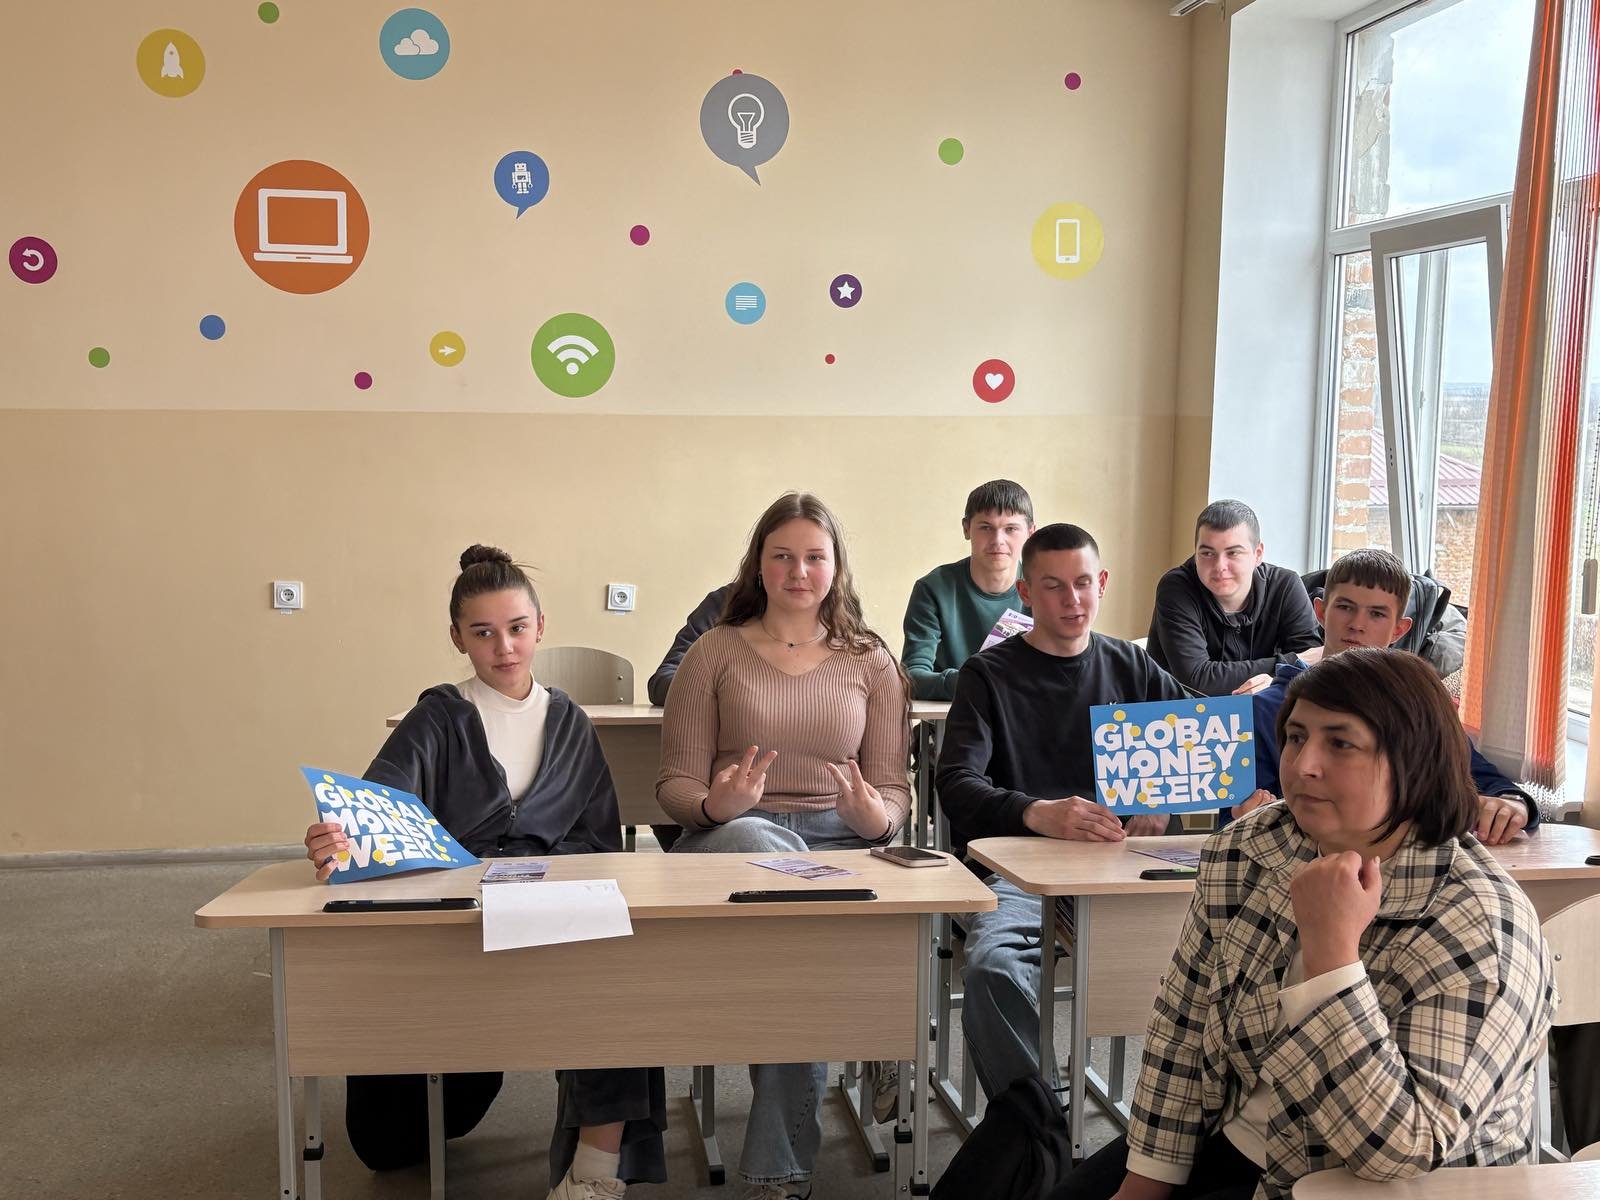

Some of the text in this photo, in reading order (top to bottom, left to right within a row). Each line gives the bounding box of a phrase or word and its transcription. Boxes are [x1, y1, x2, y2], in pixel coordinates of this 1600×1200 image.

[1094, 714, 1253, 751] GLOBAL
[1096, 742, 1239, 779] MONEY
[314, 782, 439, 825] GLOBAL
[1097, 773, 1218, 807] WEEK
[321, 808, 438, 842] MONEY
[331, 833, 445, 872] WEEK
